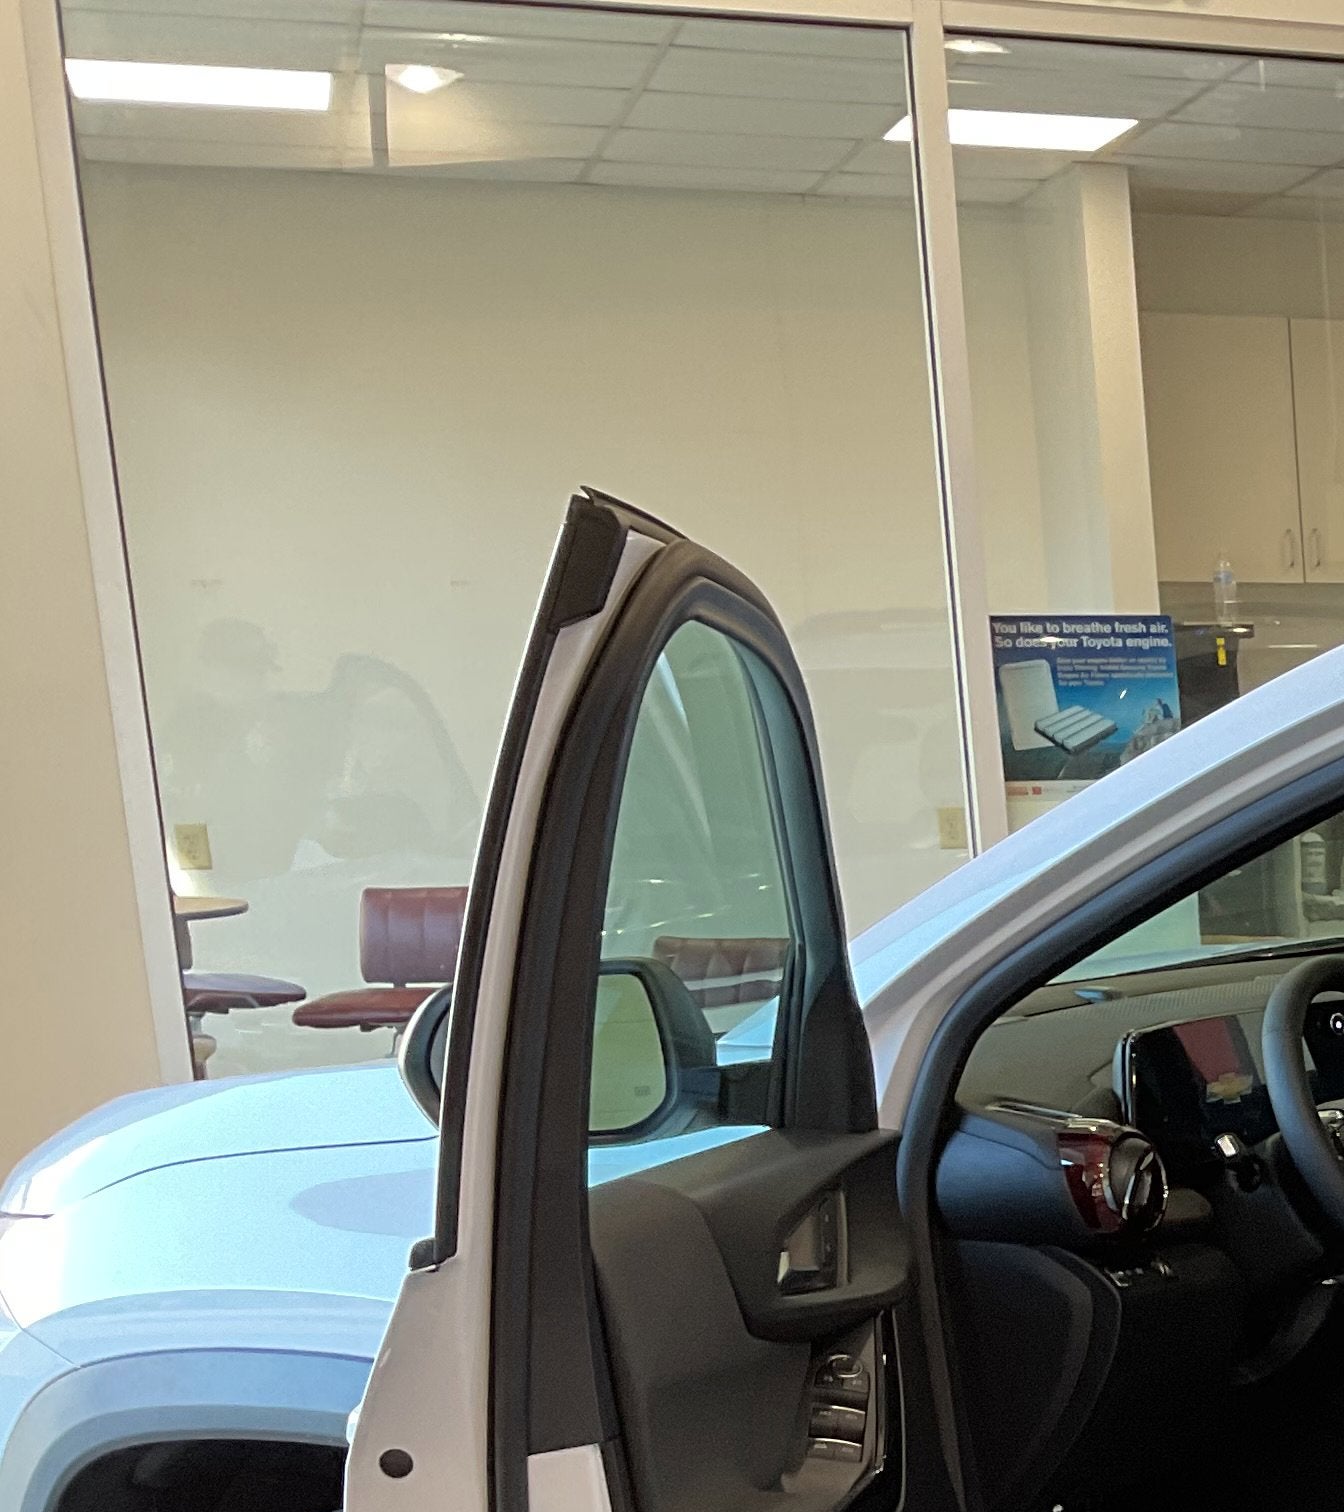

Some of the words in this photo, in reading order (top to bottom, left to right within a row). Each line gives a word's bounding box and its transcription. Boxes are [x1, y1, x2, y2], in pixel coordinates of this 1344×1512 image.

[992, 622, 1017, 634] You
[1020, 621, 1043, 634] like
[1046, 622, 1060, 633] to
[1063, 621, 1112, 634] breathe
[1115, 621, 1147, 634] fresh
[993, 635, 1013, 648] So
[1080, 635, 1123, 650] Toyota
[1126, 636, 1173, 650] engine.
